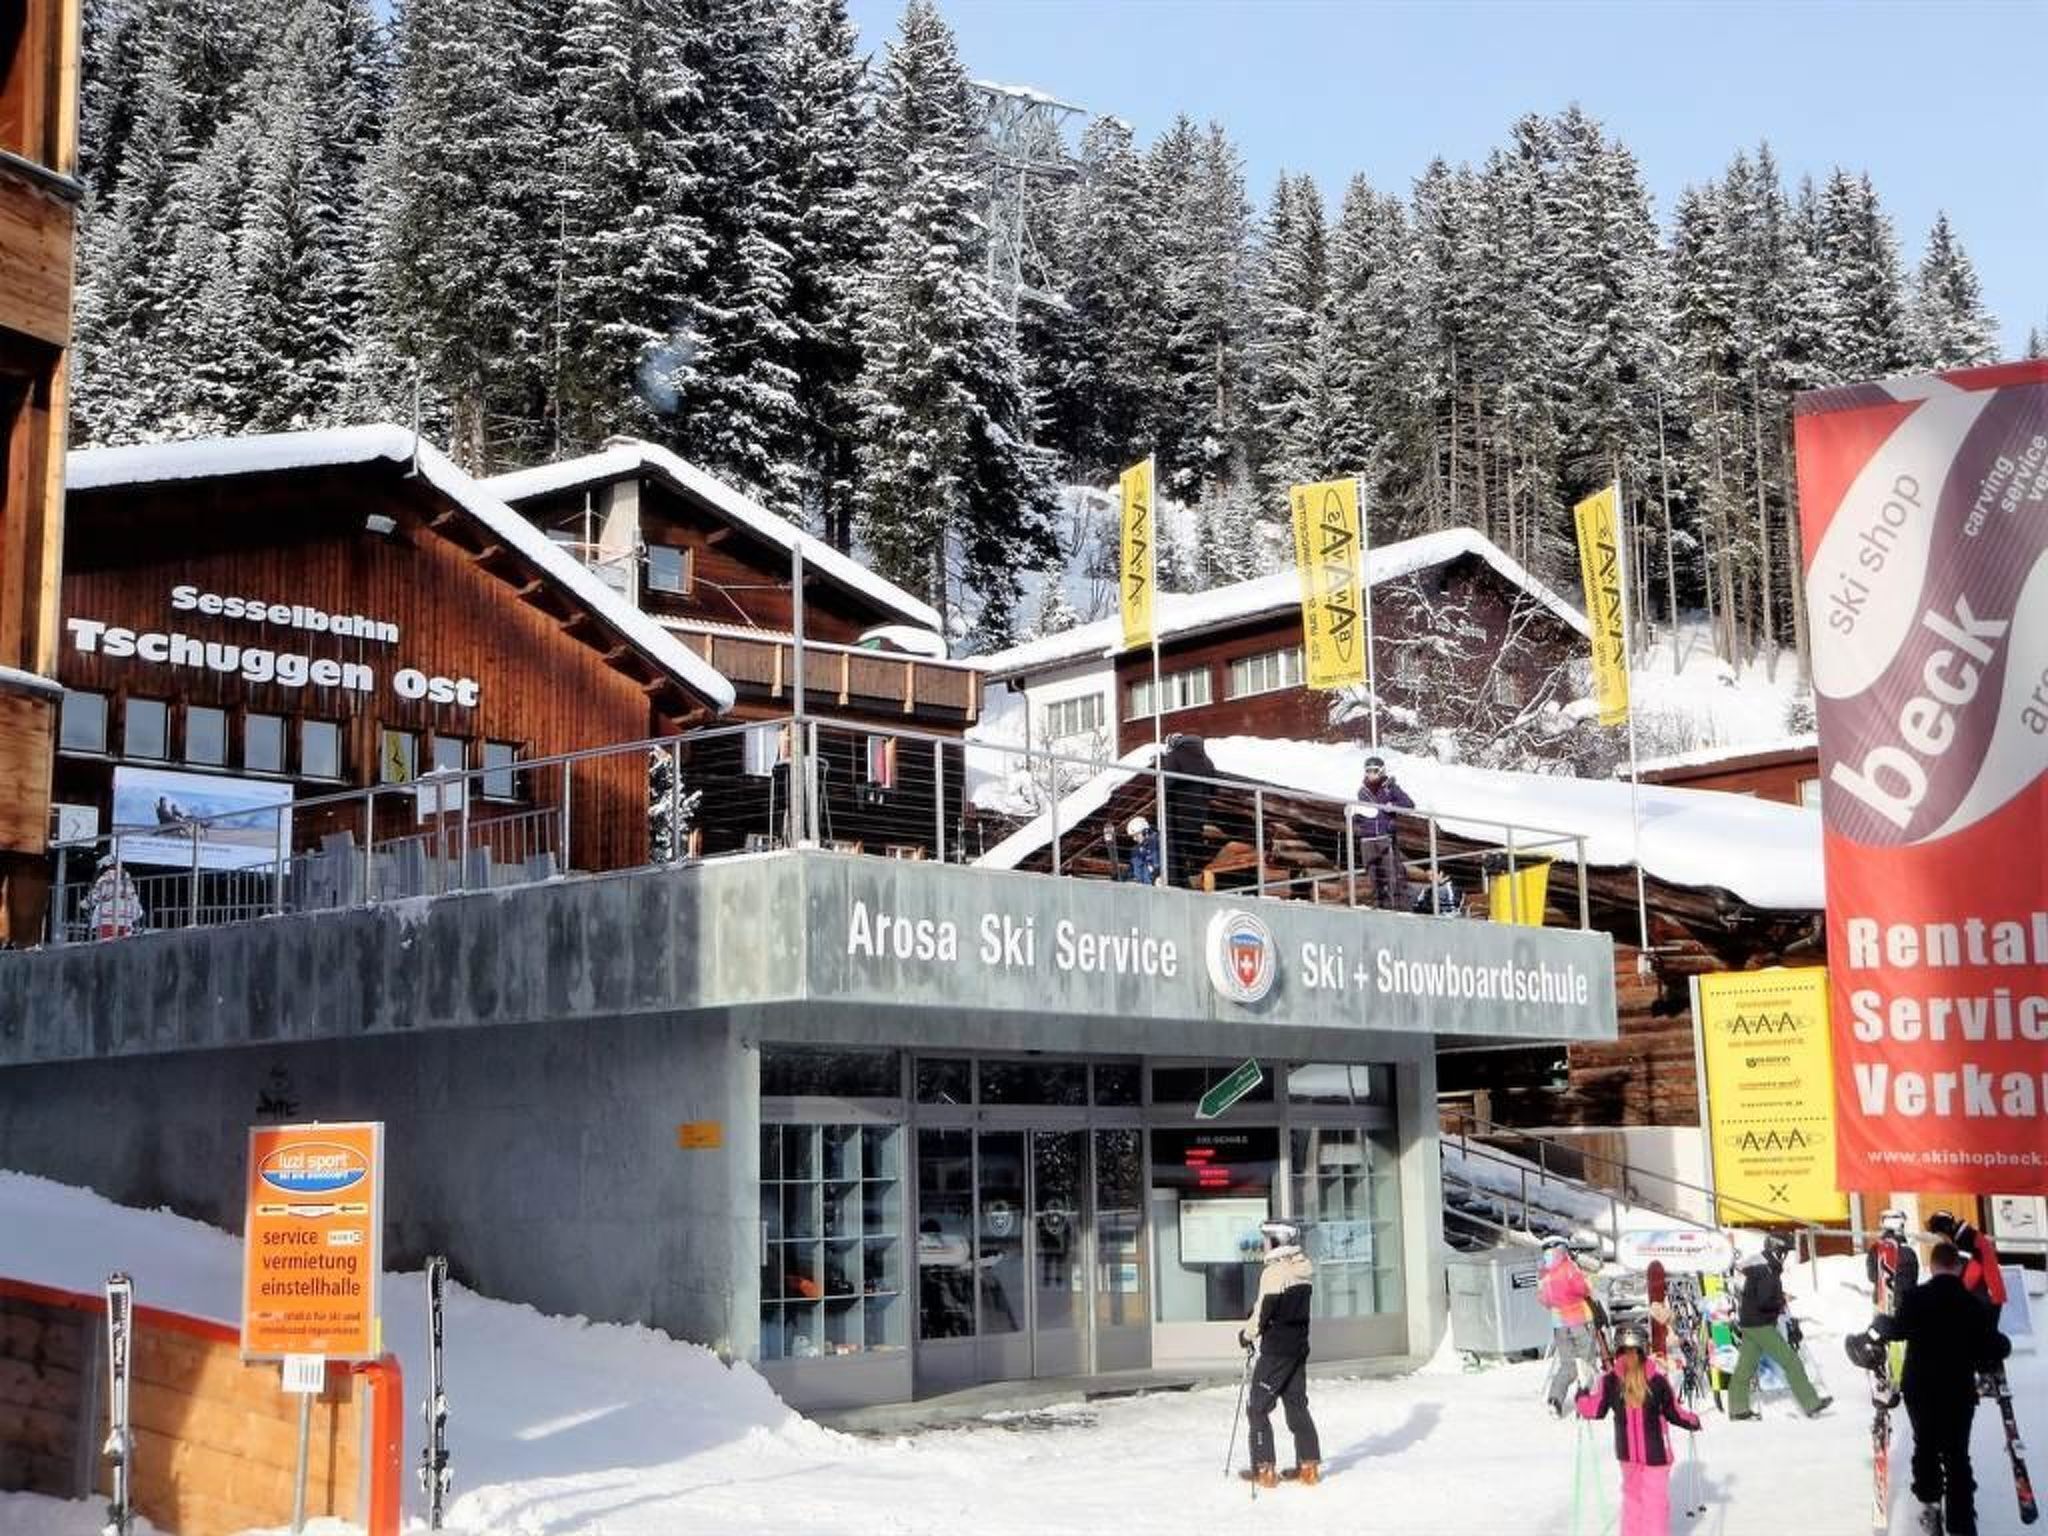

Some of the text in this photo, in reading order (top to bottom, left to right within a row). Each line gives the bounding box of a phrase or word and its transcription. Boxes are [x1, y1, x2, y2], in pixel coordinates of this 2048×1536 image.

[1964, 456, 2015, 537] carving
[2001, 435, 2047, 513] service
[1829, 473, 1922, 636] ski shop
[171, 585, 399, 643] Sesselbahn
[67, 617, 479, 708] Tschuggen Ost
[1830, 593, 2008, 829] beck
[848, 901, 1178, 977] Arosa Ski Service
[1848, 912, 2048, 969] Rental
[1302, 944, 1588, 1005] Ski + Snowboardschule
[1851, 989, 2048, 1042] Servic
[1853, 1064, 2048, 1117] Verka
[263, 1227, 318, 1245] service
[263, 1251, 357, 1275] vermietung
[261, 1278, 360, 1296] einstellhalle
